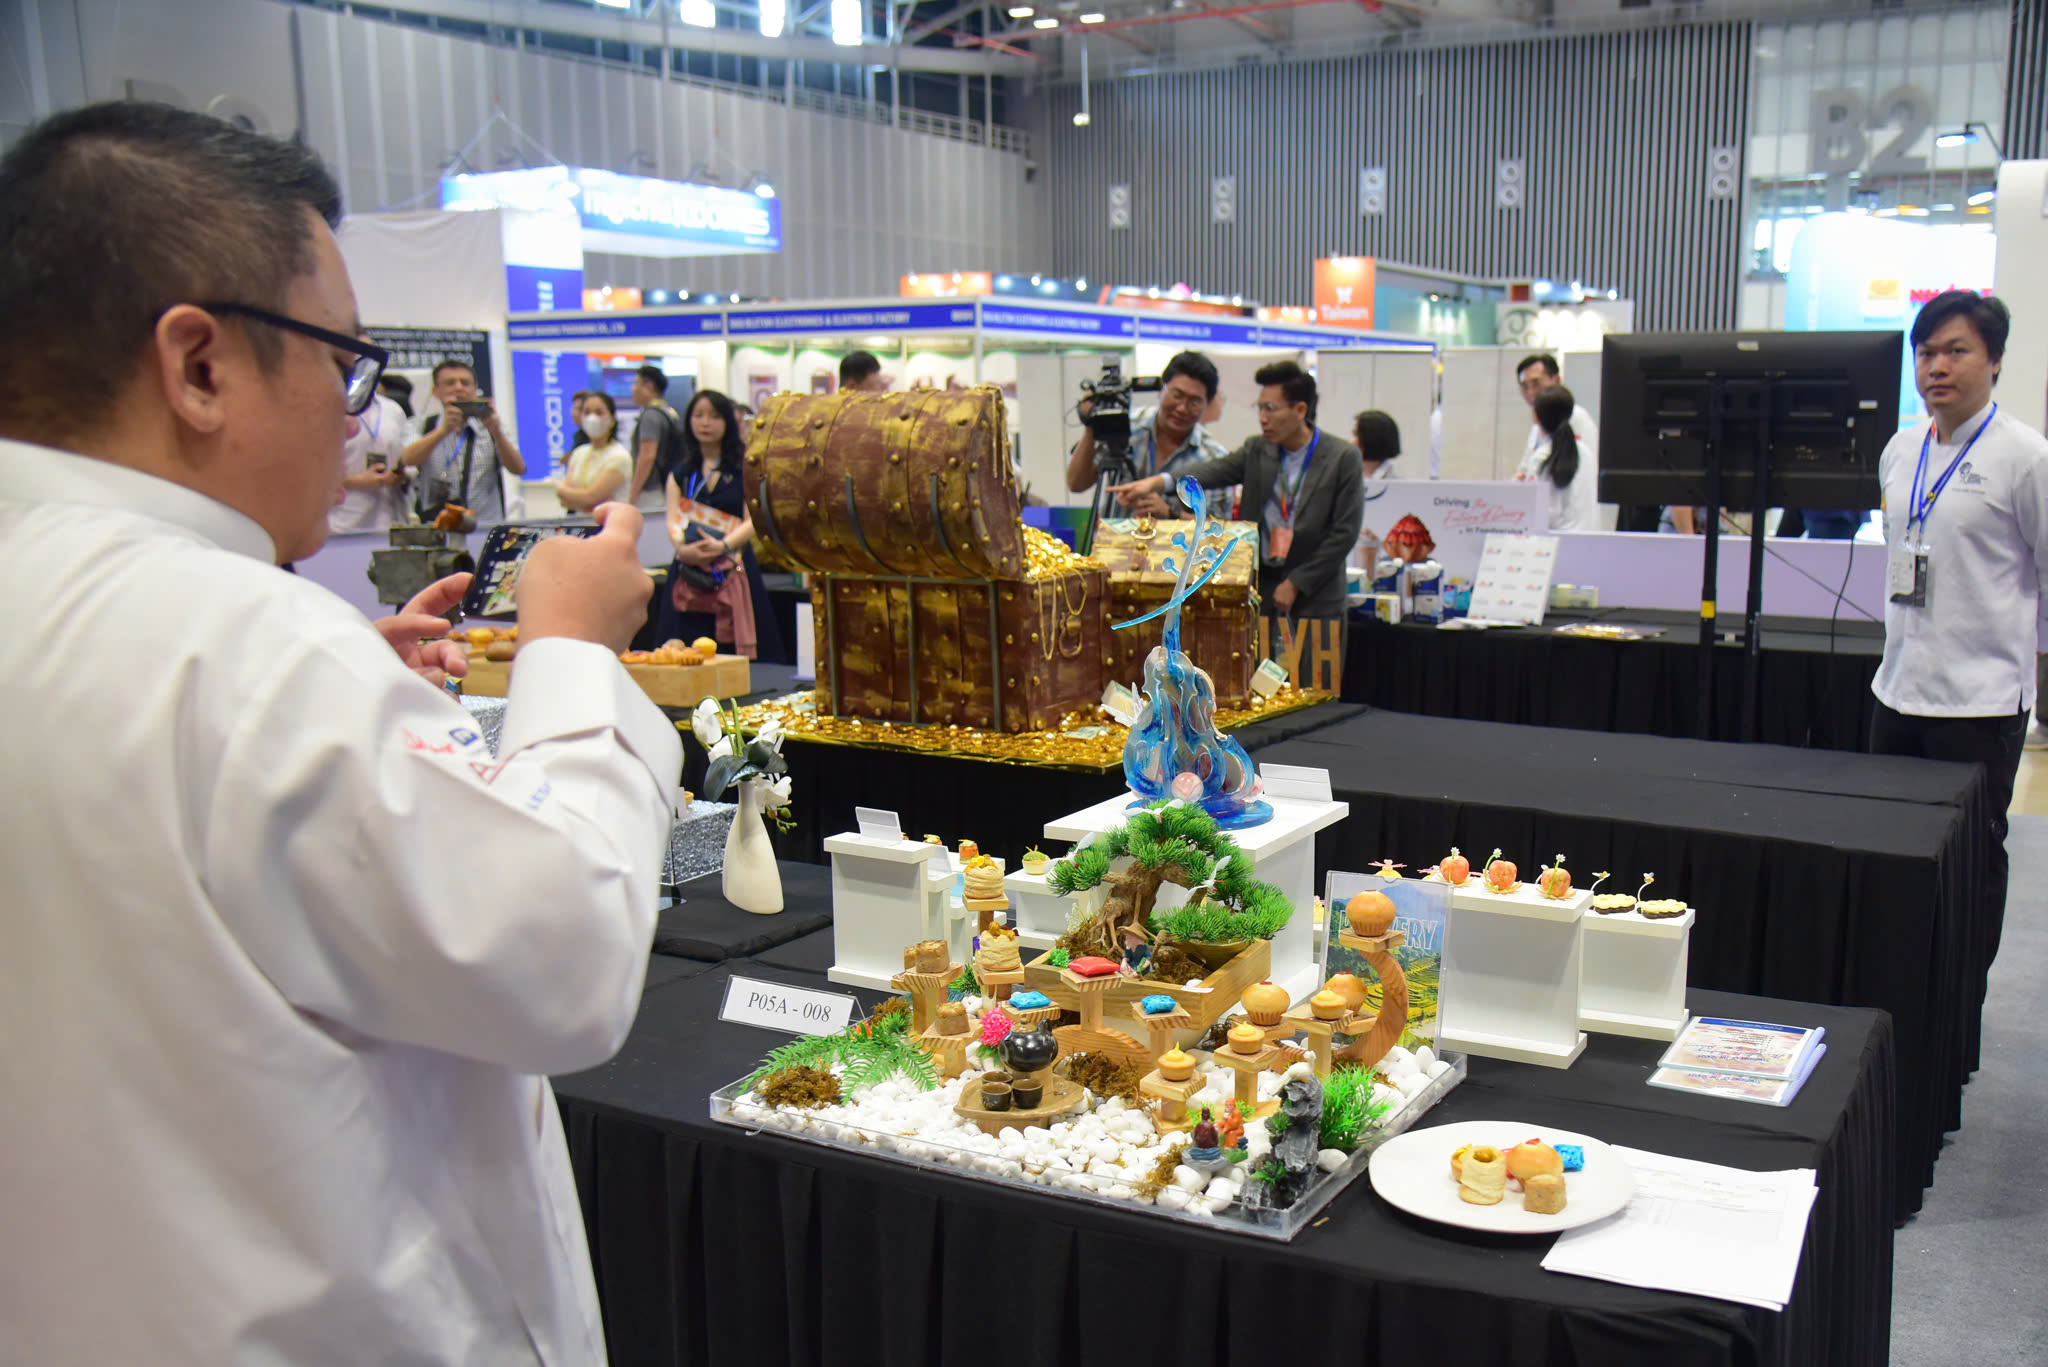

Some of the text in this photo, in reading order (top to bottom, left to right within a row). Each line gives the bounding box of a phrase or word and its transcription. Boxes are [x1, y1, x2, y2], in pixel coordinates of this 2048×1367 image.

[1809, 86, 1932, 174] B2
[1321, 304, 1369, 320] Taiwan
[1433, 497, 1470, 509] Driving
[748, 991, 788, 1014] P05A
[803, 1002, 832, 1023] 008
